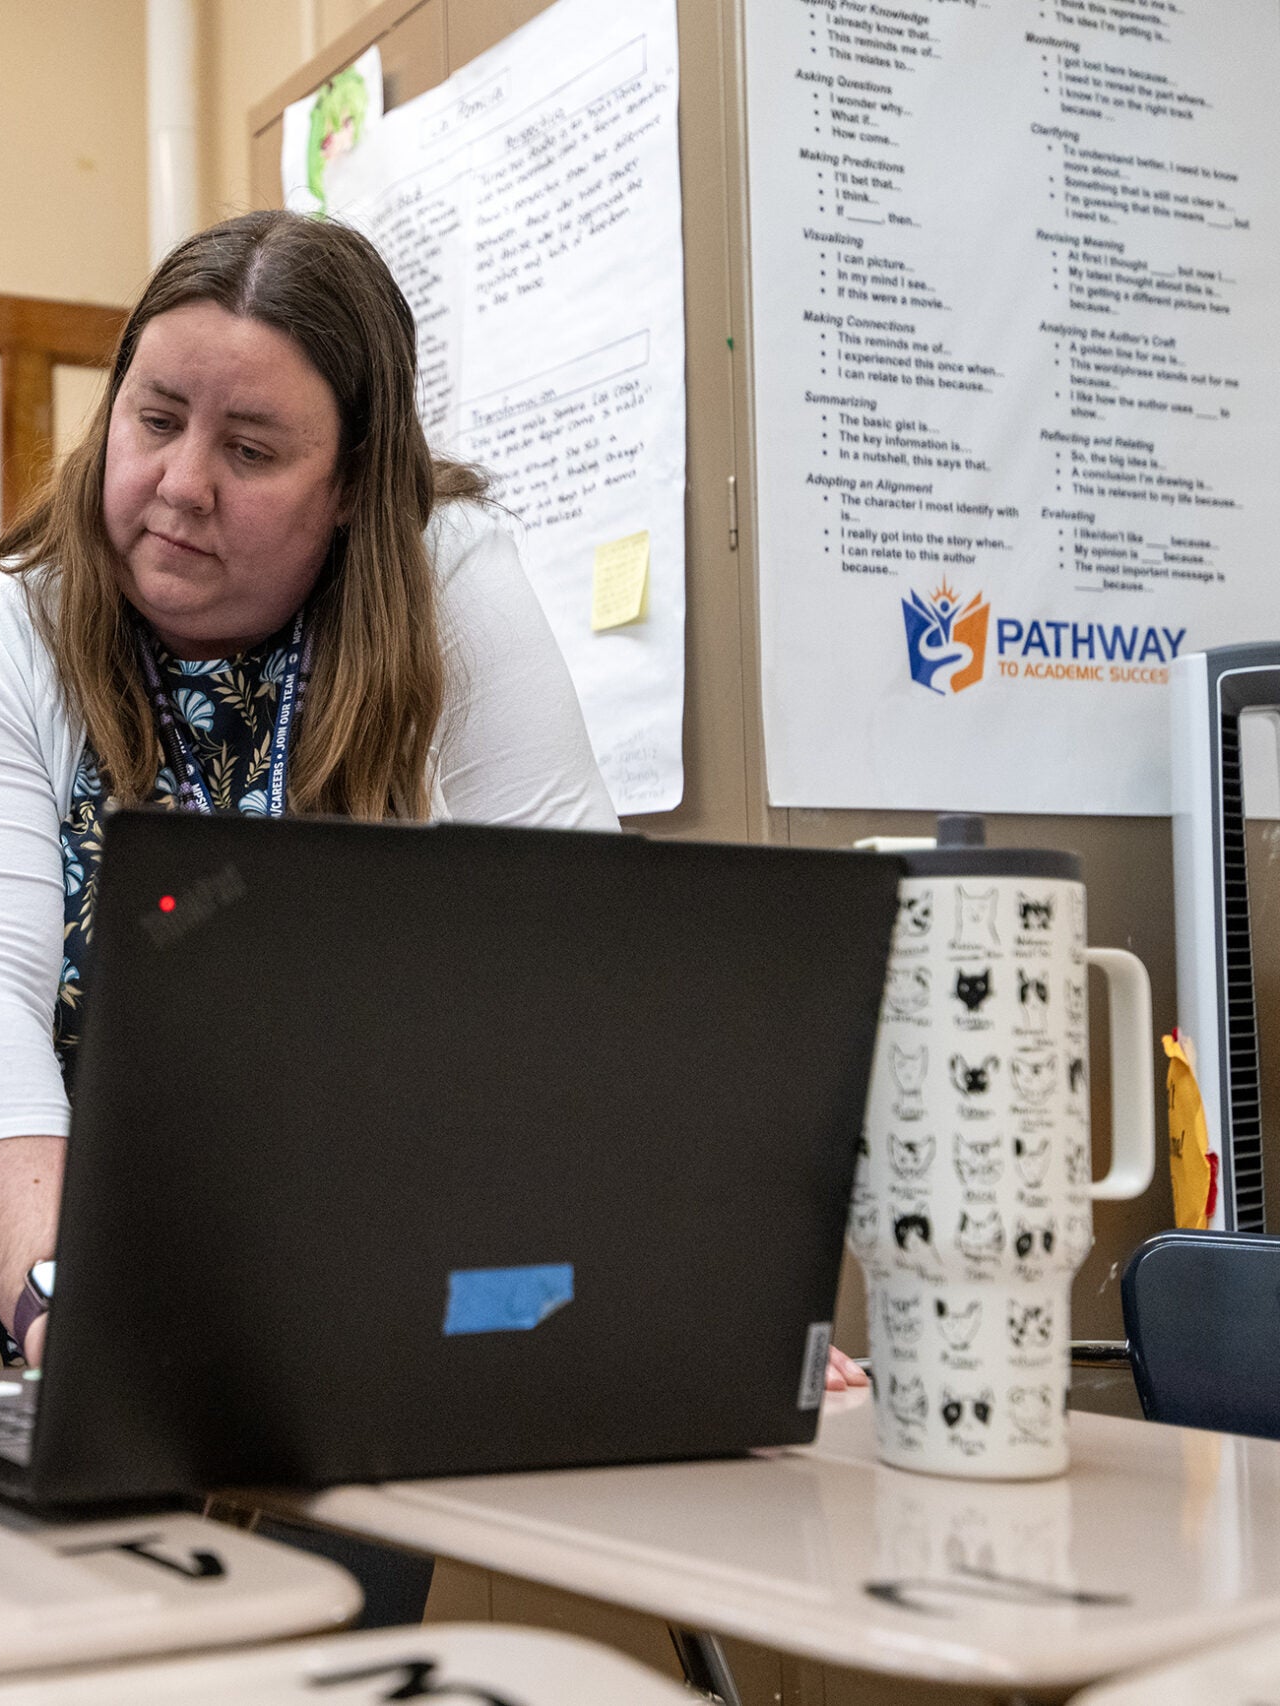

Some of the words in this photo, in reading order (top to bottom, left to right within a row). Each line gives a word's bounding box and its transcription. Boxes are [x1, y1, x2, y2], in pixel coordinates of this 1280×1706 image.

[833, 14, 872, 31] already
[876, 21, 903, 34] know
[828, 30, 850, 43] This
[855, 35, 897, 50] reminds
[901, 44, 917, 54] me
[829, 47, 851, 60] This
[855, 52, 890, 66] relates
[795, 69, 833, 86] Asking
[836, 76, 892, 94] Questions
[836, 93, 876, 109] wonder
[831, 109, 858, 122] What
[832, 126, 855, 139] How
[799, 149, 839, 165] Making
[842, 155, 904, 172] Predictions
[834, 171, 847, 182] I'll
[851, 174, 867, 185] bet
[837, 205, 844, 215] If
[803, 229, 863, 248] Visualizing
[844, 254, 863, 264] can
[838, 269, 848, 280] In
[851, 273, 866, 284] my
[870, 274, 897, 286] mind
[838, 287, 844, 297] If
[848, 288, 868, 299] this
[872, 292, 897, 303] were
[804, 311, 842, 326] Making
[846, 315, 915, 332] Connections
[839, 332, 860, 344] This
[865, 335, 908, 349] reminds
[912, 342, 928, 351] me
[844, 350, 910, 368] experienced
[914, 357, 934, 368] this
[937, 361, 963, 372] once
[844, 369, 864, 378] can
[868, 370, 898, 382] relate
[901, 373, 912, 383] to
[915, 375, 934, 386] this
[805, 391, 876, 409] Summarizing
[839, 414, 859, 425] The
[863, 416, 890, 427] basic
[895, 418, 915, 431] gist
[839, 431, 859, 442] The
[863, 433, 881, 445] key
[885, 435, 947, 449] information
[840, 449, 850, 458] In
[862, 450, 909, 465] nutshell,
[912, 454, 932, 465] this
[936, 458, 961, 469] says
[806, 474, 856, 488] Adopting
[859, 479, 872, 488] an
[876, 479, 932, 494] Alignment
[841, 494, 860, 505] The
[864, 496, 915, 509] character
[925, 500, 952, 511] most
[956, 502, 993, 517] identify
[996, 505, 1019, 516] with
[847, 528, 877, 540] really
[880, 530, 898, 542] got
[902, 531, 923, 542] into
[926, 533, 943, 543] the
[947, 534, 972, 547] story
[848, 547, 867, 556] can
[871, 547, 901, 558] relate
[905, 549, 916, 559] to
[919, 550, 939, 561] this
[942, 552, 975, 563] author
[997, 618, 1187, 663] PATHWAY
[998, 661, 1019, 677] TO
[1024, 662, 1104, 682] ACADEMIC
[1109, 665, 1169, 685] SUCCES
[283, 673, 296, 702] TEAM
[280, 703, 291, 725] OUR
[276, 726, 288, 751] JOIN
[270, 762, 284, 818] /CAREERS
